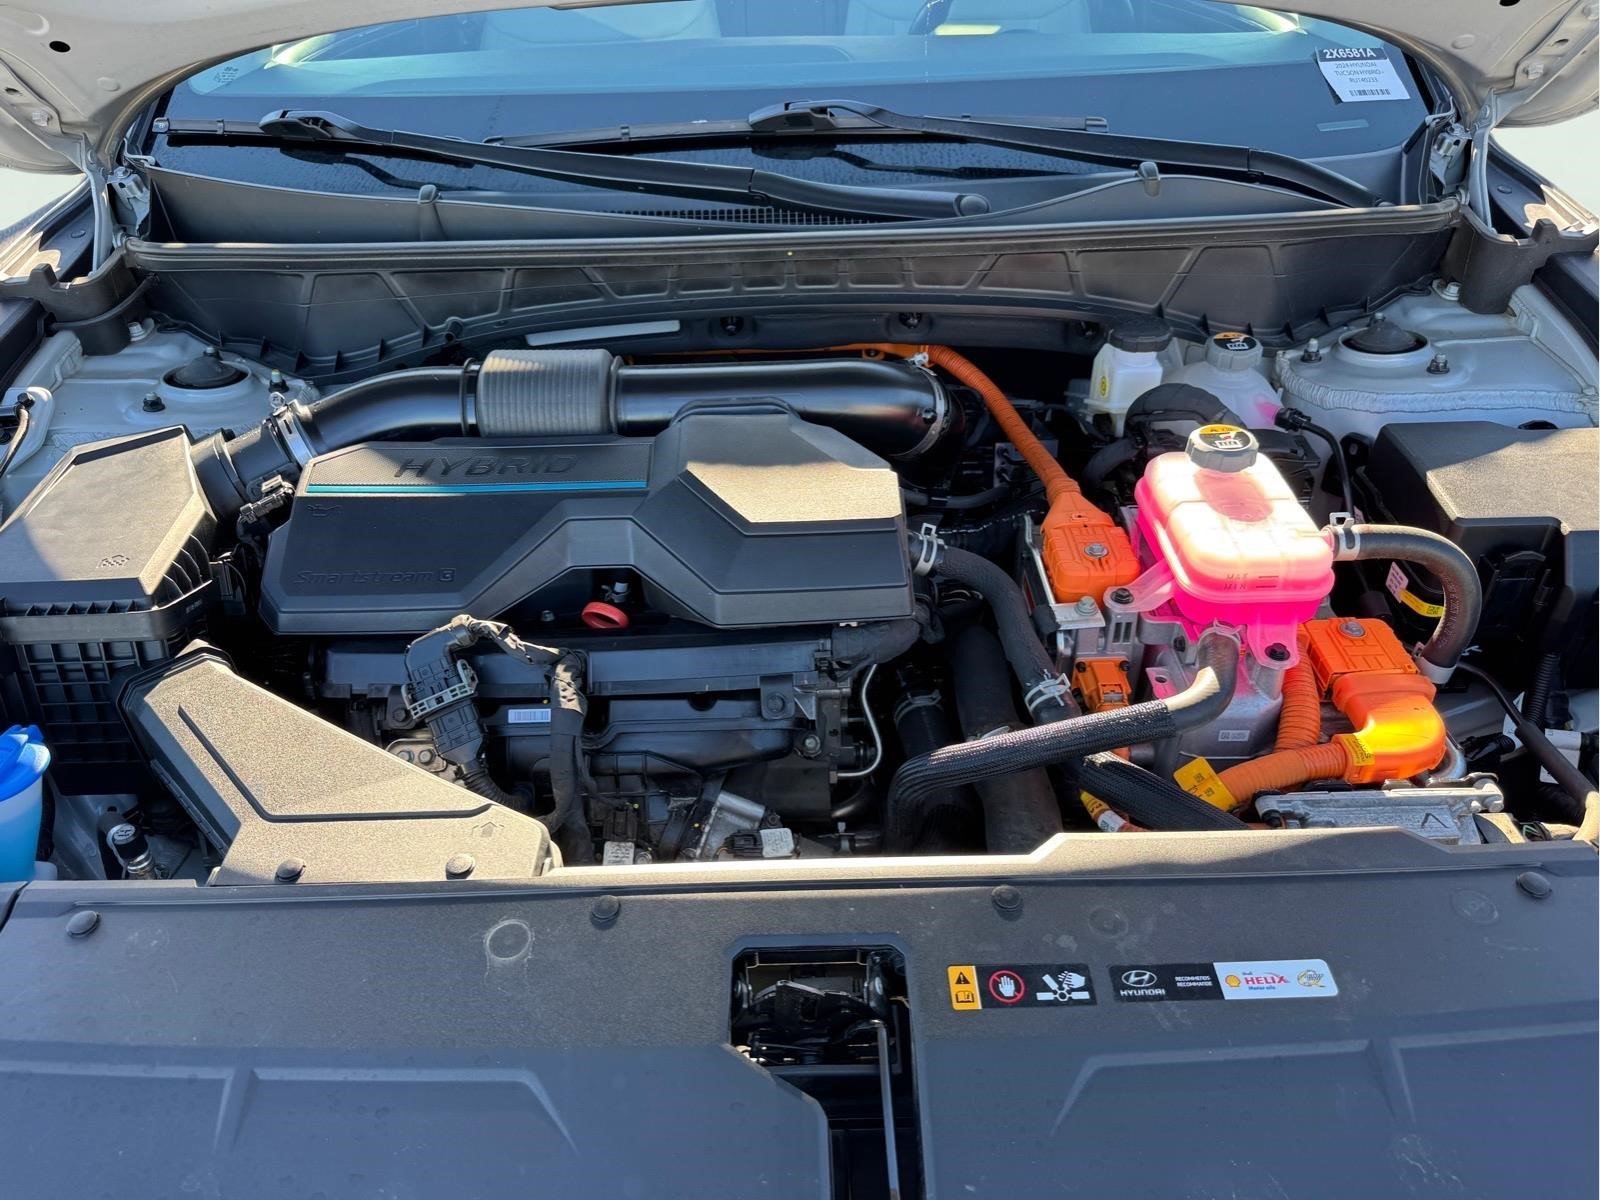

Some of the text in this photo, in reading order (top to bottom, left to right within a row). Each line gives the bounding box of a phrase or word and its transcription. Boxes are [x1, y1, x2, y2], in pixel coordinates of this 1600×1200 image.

[1323, 48, 1376, 58] 2X6581A
[394, 455, 578, 477] HYBRID
[294, 570, 433, 585] Smartstream
[1244, 975, 1289, 985] HELIX
[1120, 989, 1166, 997] HYUNDAI
